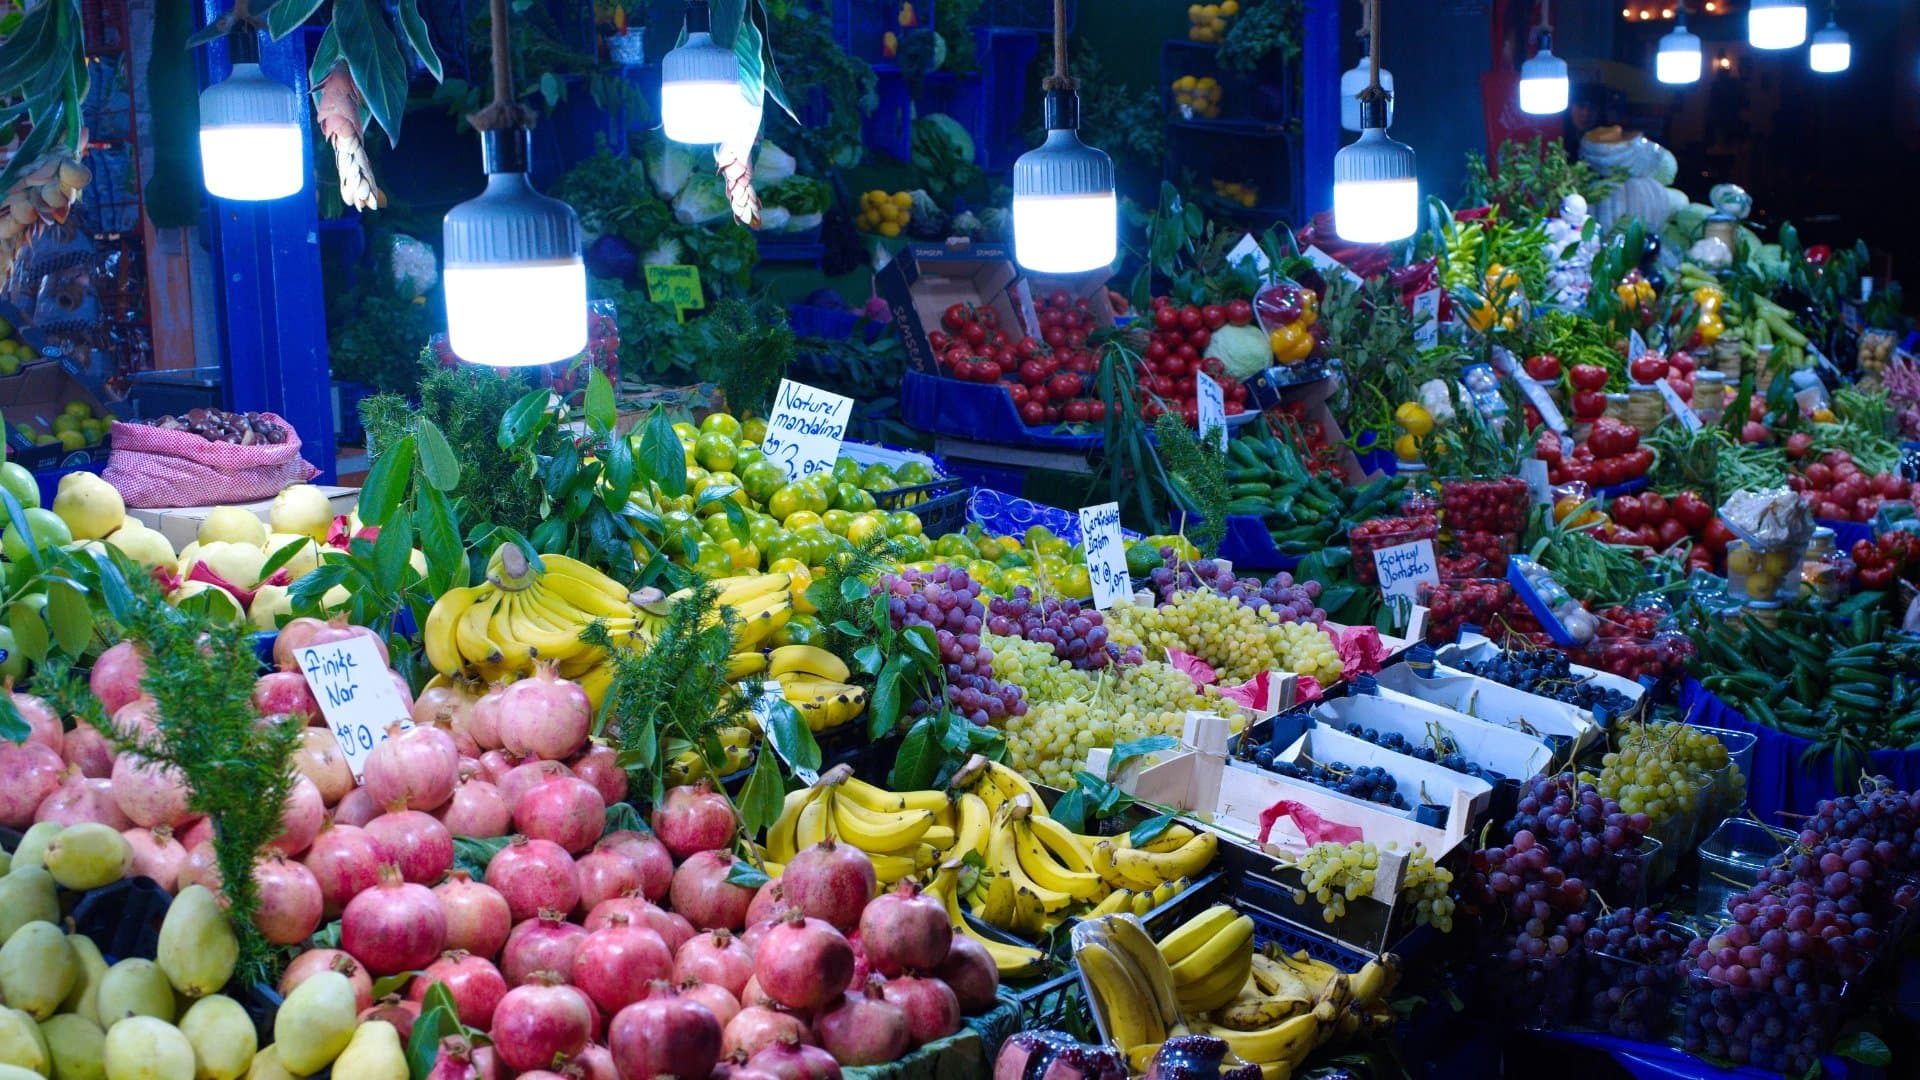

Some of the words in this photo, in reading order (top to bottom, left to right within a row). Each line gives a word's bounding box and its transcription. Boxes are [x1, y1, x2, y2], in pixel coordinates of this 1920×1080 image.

[778, 382, 844, 417] Naturel
[773, 413, 843, 441] mandalina
[304, 648, 359, 685] Finike
[325, 681, 359, 709] Nar
